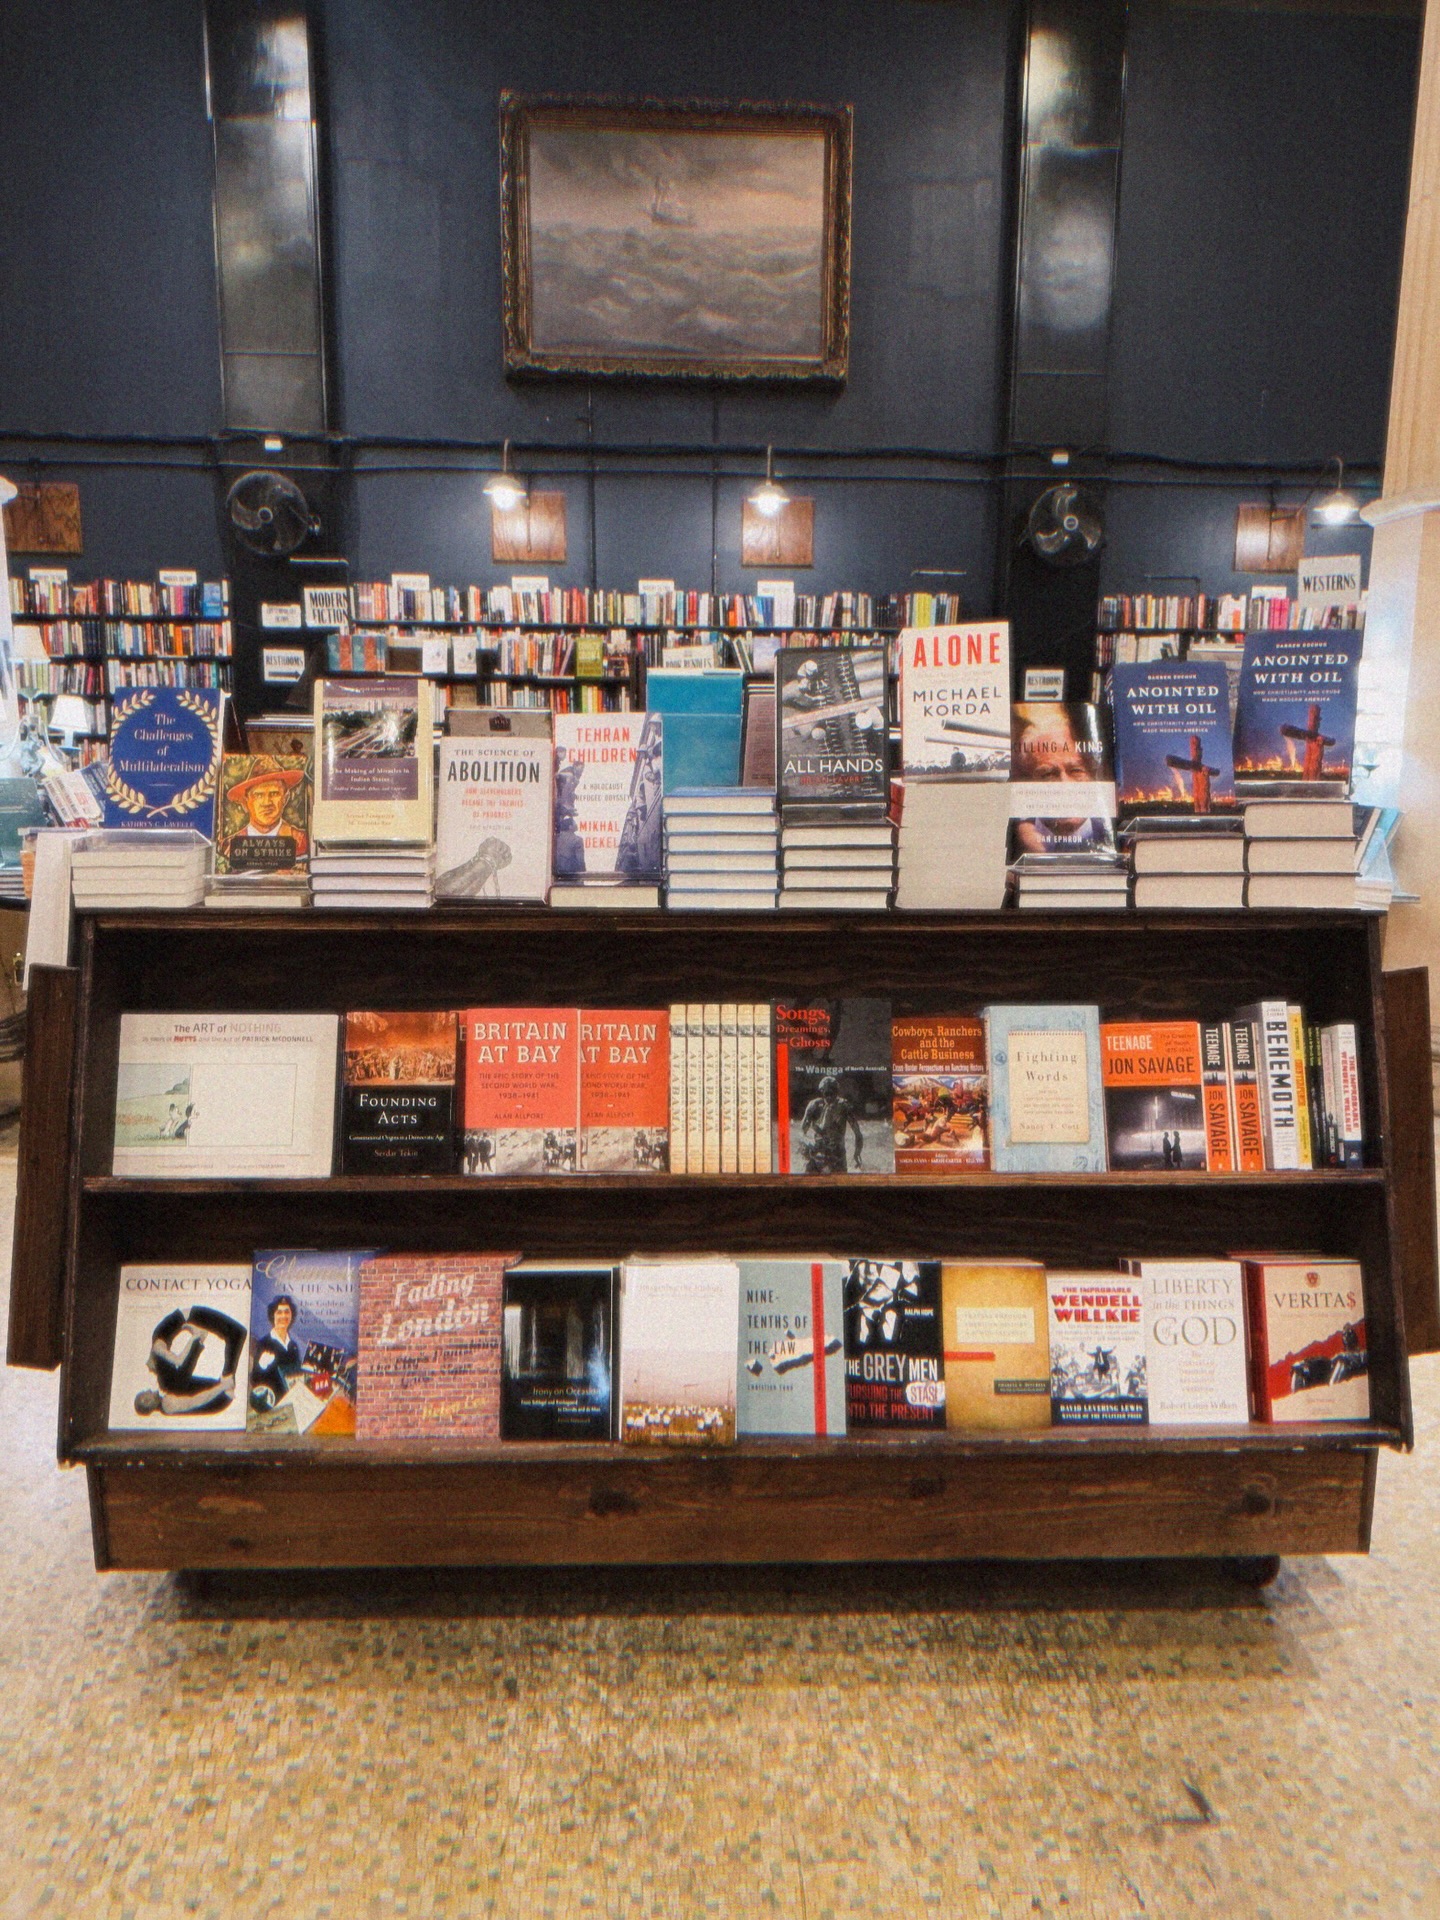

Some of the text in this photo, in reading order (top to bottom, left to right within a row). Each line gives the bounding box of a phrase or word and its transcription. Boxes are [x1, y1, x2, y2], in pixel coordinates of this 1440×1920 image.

[1303, 574, 1356, 592] WESTERNS
[309, 592, 348, 608] MODERN
[311, 608, 348, 624] FICTION
[913, 632, 1001, 668] ALONE
[266, 655, 303, 666] RESTROOMS
[1251, 654, 1349, 667] ANOINTED
[1027, 675, 1061, 685] RESTROOMS
[1254, 671, 1342, 684] WITH OIL
[913, 686, 1002, 702] MICHAEL
[1126, 686, 1219, 698] ANOINTED
[924, 703, 991, 717] KORDA
[1131, 703, 1217, 715] WITH OIL
[154, 713, 176, 725] The
[134, 729, 194, 741] Challenges
[576, 727, 630, 743] TEHRAN
[156, 746, 169, 756] of
[1062, 741, 1069, 753] A
[1074, 741, 1103, 753] KING
[568, 748, 638, 763] CHILDREN
[119, 760, 205, 773] Multilateralism
[447, 761, 540, 783] ABOLITION
[784, 759, 884, 774] ALL HANDS
[579, 821, 620, 832] MIKHAL
[585, 837, 620, 849] DEKEL
[1036, 835, 1083, 843] DAN EPHRON
[234, 848, 292, 856] ON STRIKE
[776, 1004, 831, 1024] Songs,
[174, 1024, 282, 1033] The ART of NOTHING
[474, 1022, 567, 1041] BRITAIN
[581, 1023, 656, 1041] RITAIN
[776, 1024, 831, 1034] Dreamings,
[937, 1026, 982, 1037] Ranchers
[789, 1037, 831, 1048] Ghosts
[919, 1038, 955, 1048] and the
[1106, 1035, 1153, 1051] TEENAGE
[1205, 1028, 1220, 1066] TEENAGE
[1235, 1027, 1250, 1065] TEENAGE
[478, 1045, 561, 1063] AT BAY
[609, 1046, 651, 1063] BAY
[901, 1049, 975, 1060] Cattle Business
[1016, 1051, 1078, 1064] Fighting
[805, 1065, 844, 1076] Wangga
[1108, 1056, 1196, 1074] JON SAVAGE
[1026, 1070, 1069, 1082] Words
[1267, 1021, 1294, 1128] BEHEMOTH
[672, 1051, 680, 1133] ALABAMA
[689, 1051, 697, 1133] ALABAMA
[706, 1051, 714, 1133] ALABAMA
[740, 1051, 748, 1133] ALABAMA
[756, 1051, 764, 1133] ALABAMA
[359, 1093, 437, 1107] FOUNDING
[1351, 1075, 1360, 1129] IMPROBABLE
[377, 1111, 418, 1124] ACTS
[1209, 1090, 1228, 1157] JON SAVAGE
[1239, 1089, 1260, 1156] JON SAVAGE
[125, 1278, 252, 1291] CONTACT YOGA
[395, 1273, 474, 1307] Fading
[1152, 1278, 1233, 1295] LIBERTY
[746, 1290, 779, 1303] NINE-
[1051, 1294, 1142, 1307] WENDELL
[904, 1308, 934, 1316] RALPH HOPE
[1153, 1300, 1235, 1310] in the THINGS
[377, 1299, 489, 1346] London
[747, 1315, 808, 1329] TENTHS OF
[1054, 1308, 1141, 1323] WILLKIE
[1153, 1316, 1237, 1346] GOD
[748, 1340, 796, 1354] THE LAW
[844, 1353, 938, 1382] THE GREY MEN
[315, 1380, 329, 1391] BEA
[533, 1387, 552, 1398] Irony
[554, 1387, 563, 1396] on
[849, 1384, 938, 1403] URSUING THE STASI
[869, 1403, 887, 1419] THE
[891, 1404, 934, 1421] PRESENT
[1059, 1404, 1143, 1412] DAVID LEVERING LEWIS
[1160, 1402, 1186, 1410] Robert
